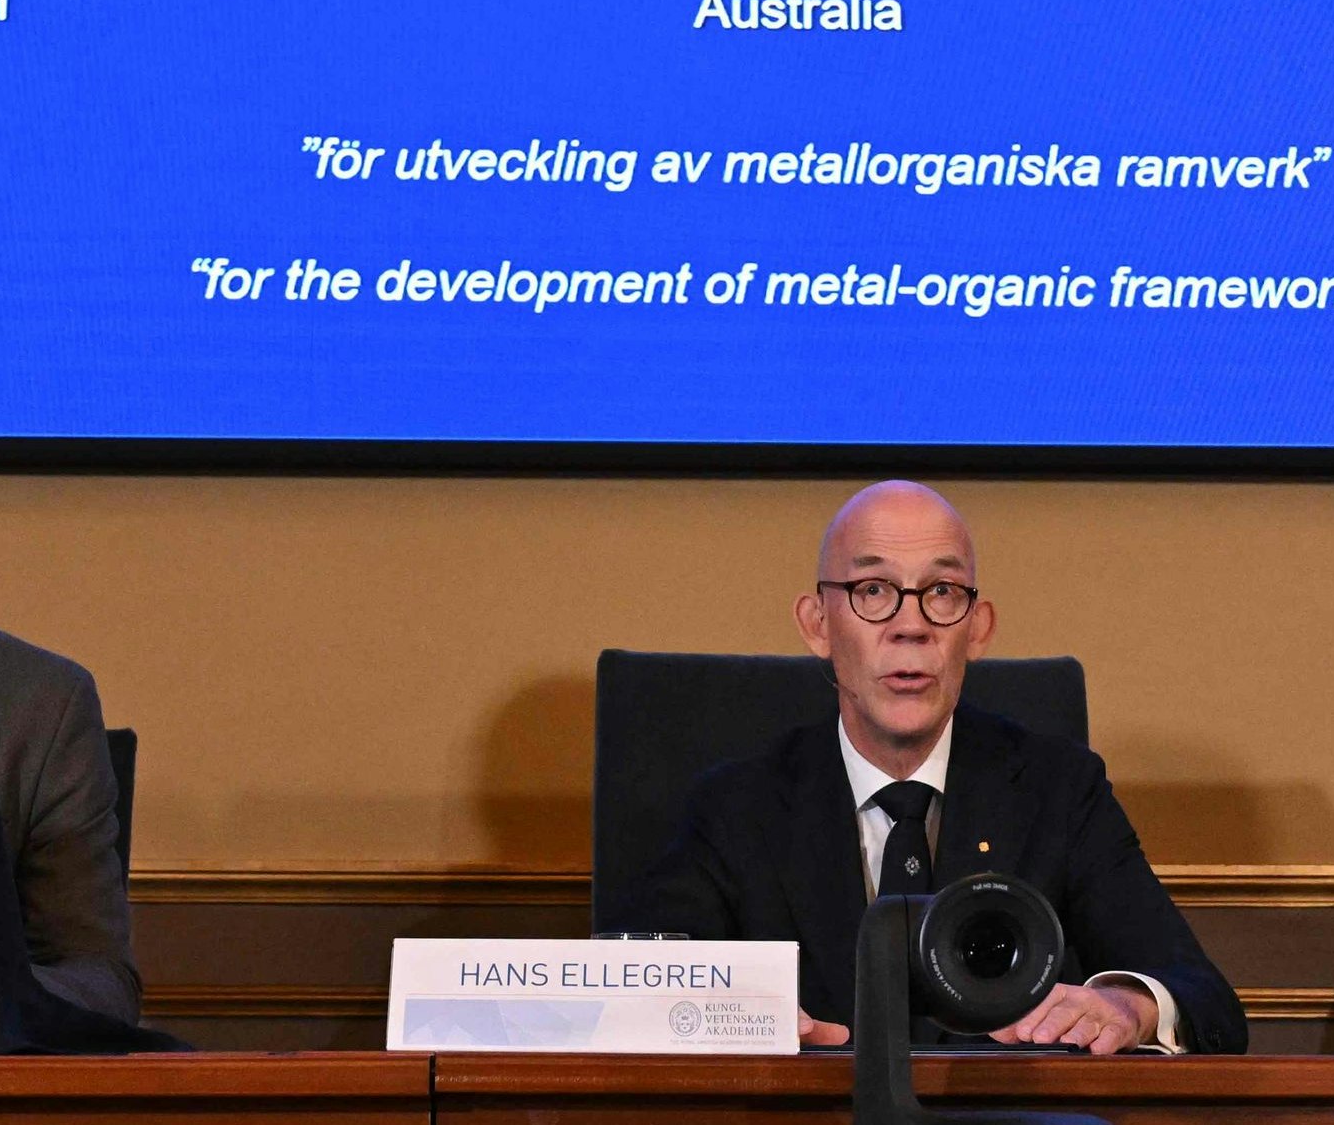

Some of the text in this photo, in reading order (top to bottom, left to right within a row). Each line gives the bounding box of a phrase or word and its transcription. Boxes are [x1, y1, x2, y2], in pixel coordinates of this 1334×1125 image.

[395, 138, 638, 192] utveckling
[651, 151, 712, 183] av
[723, 142, 1101, 195] metallorganiska
[284, 258, 361, 301] the
[376, 259, 693, 314] development
[704, 262, 758, 305] of
[764, 264, 1096, 318] metal-organic
[459, 961, 733, 990] HANS ELLEGREN
[704, 1026, 776, 1036] AKADEMIEN
